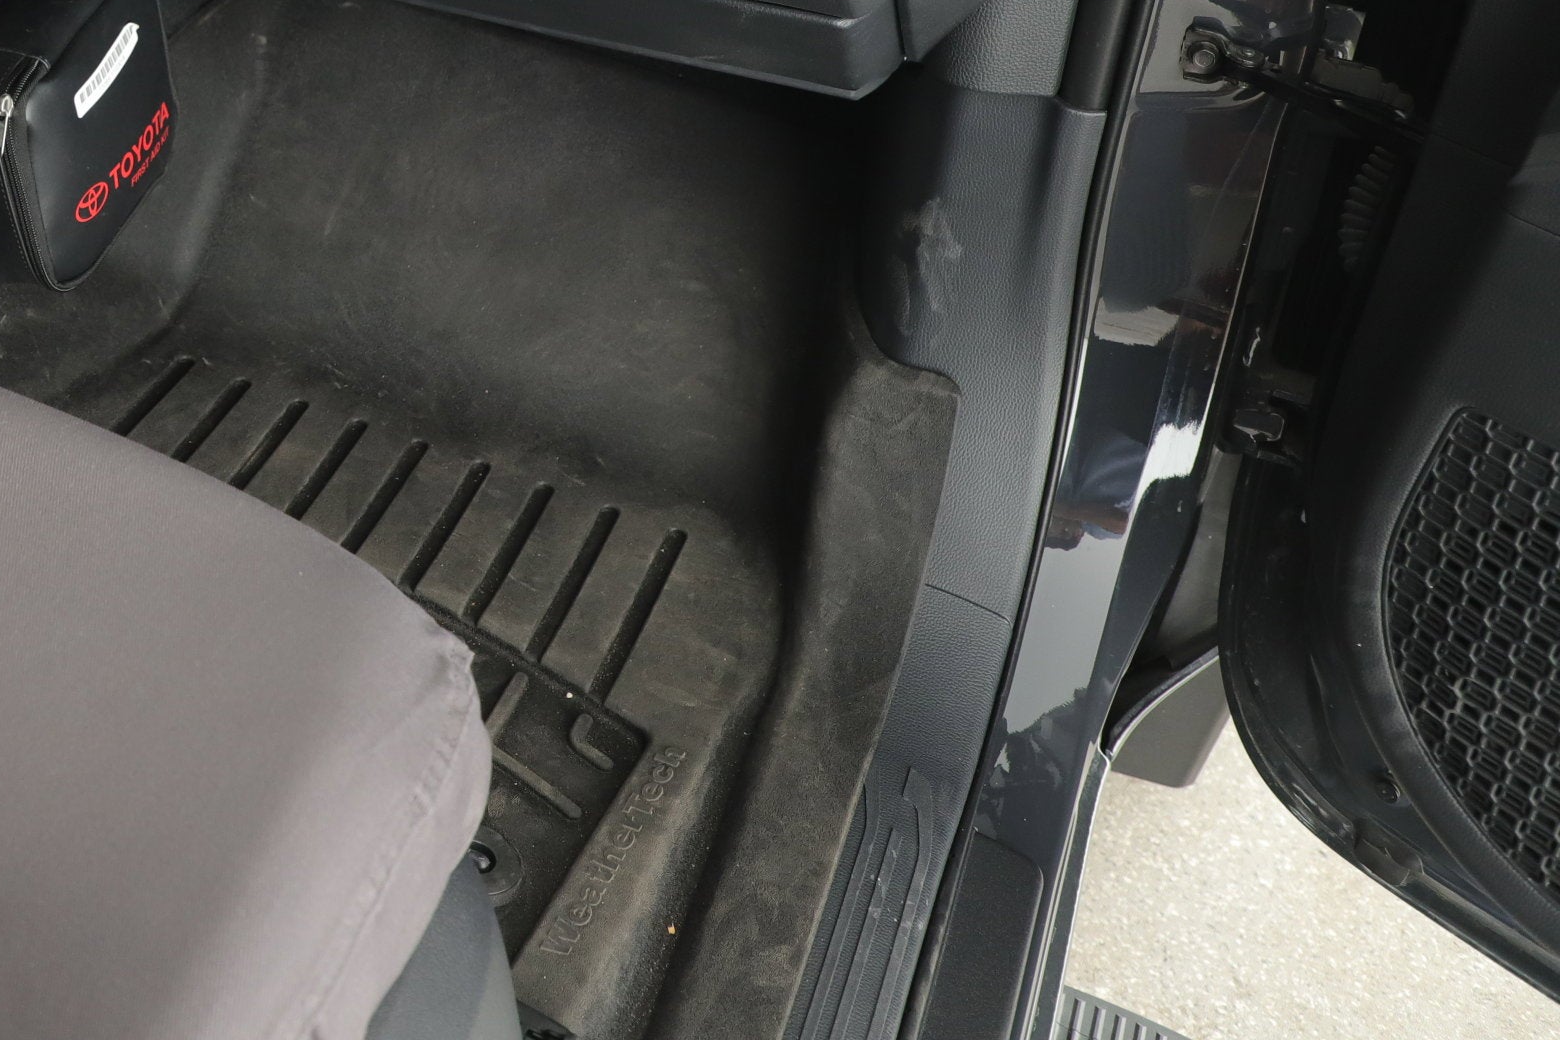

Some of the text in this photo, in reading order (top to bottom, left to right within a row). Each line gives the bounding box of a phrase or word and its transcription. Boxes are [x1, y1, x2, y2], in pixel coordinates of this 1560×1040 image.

[108, 101, 170, 190] TOYOTA
[130, 125, 170, 187] FIRST AID KIT
